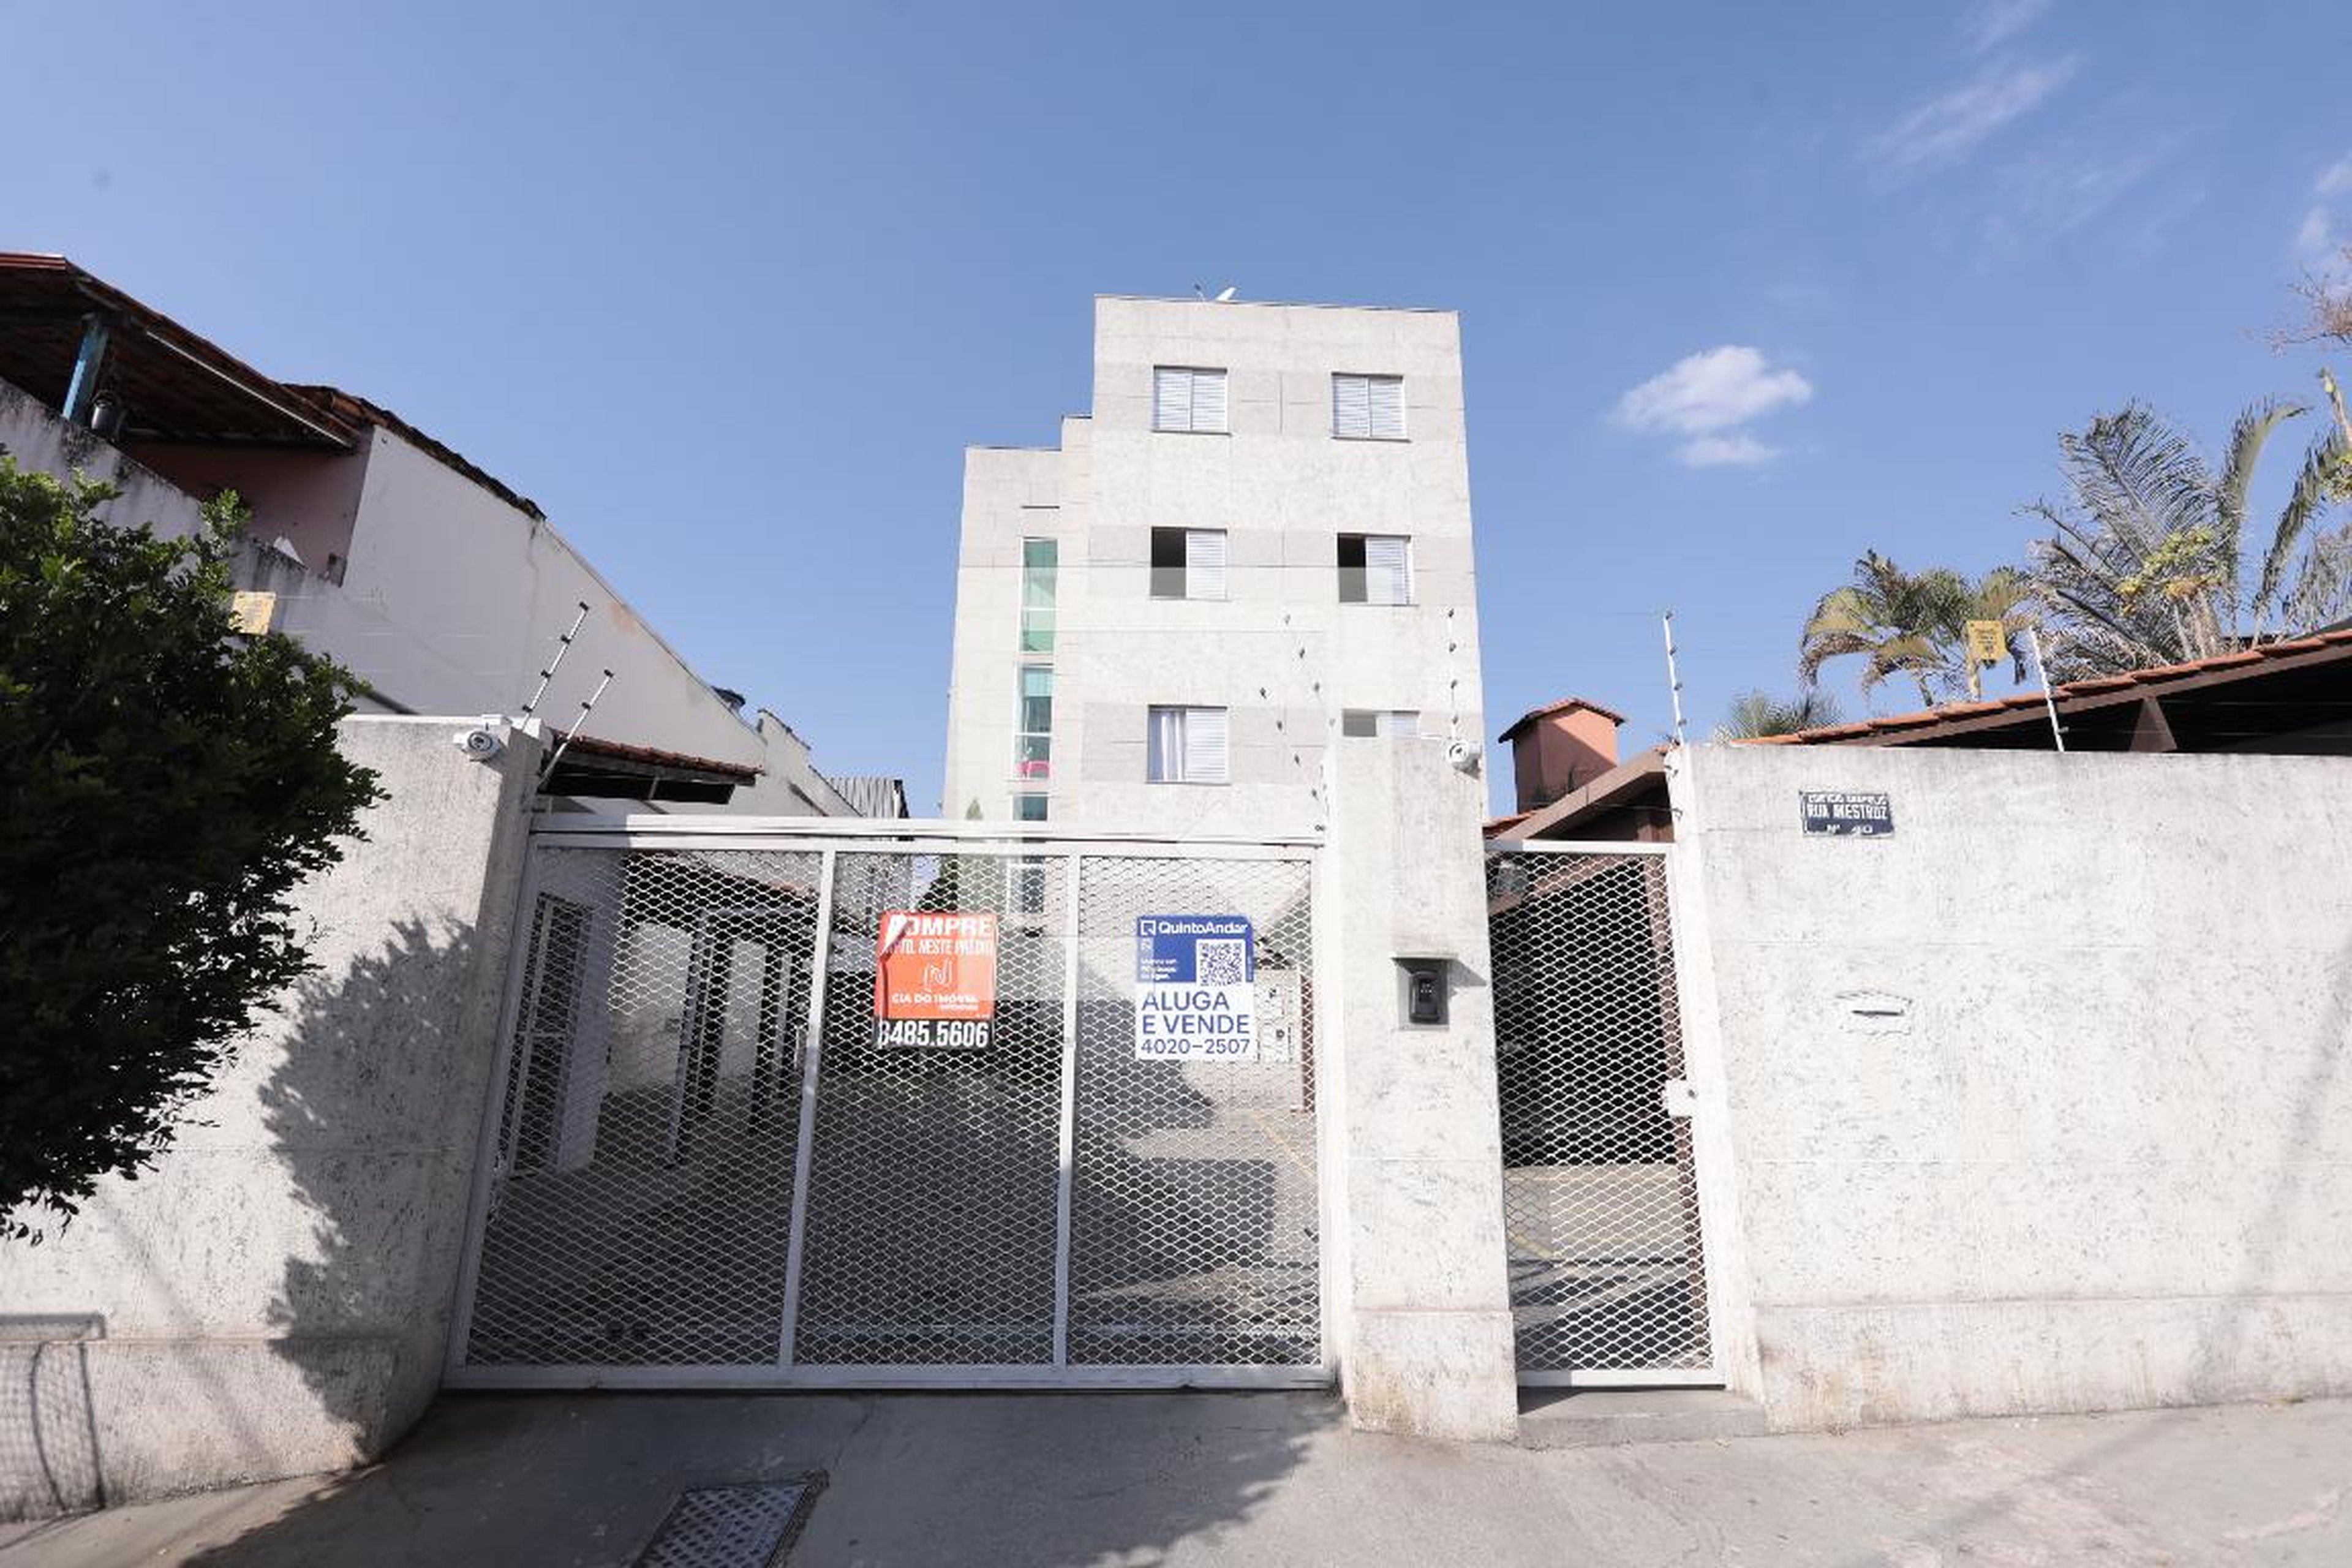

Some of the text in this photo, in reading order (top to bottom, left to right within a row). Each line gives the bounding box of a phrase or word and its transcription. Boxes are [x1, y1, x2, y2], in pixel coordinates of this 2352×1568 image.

[892, 916, 995, 936] OMPRE
[1158, 921, 1248, 935] QuintoAndar
[891, 993, 912, 1004] CIA
[914, 993, 932, 1003] DO
[1141, 991, 1230, 1011] ALUGA
[1142, 1014, 1251, 1035] E VENDE
[1140, 1039, 1251, 1054] 4020-2507
